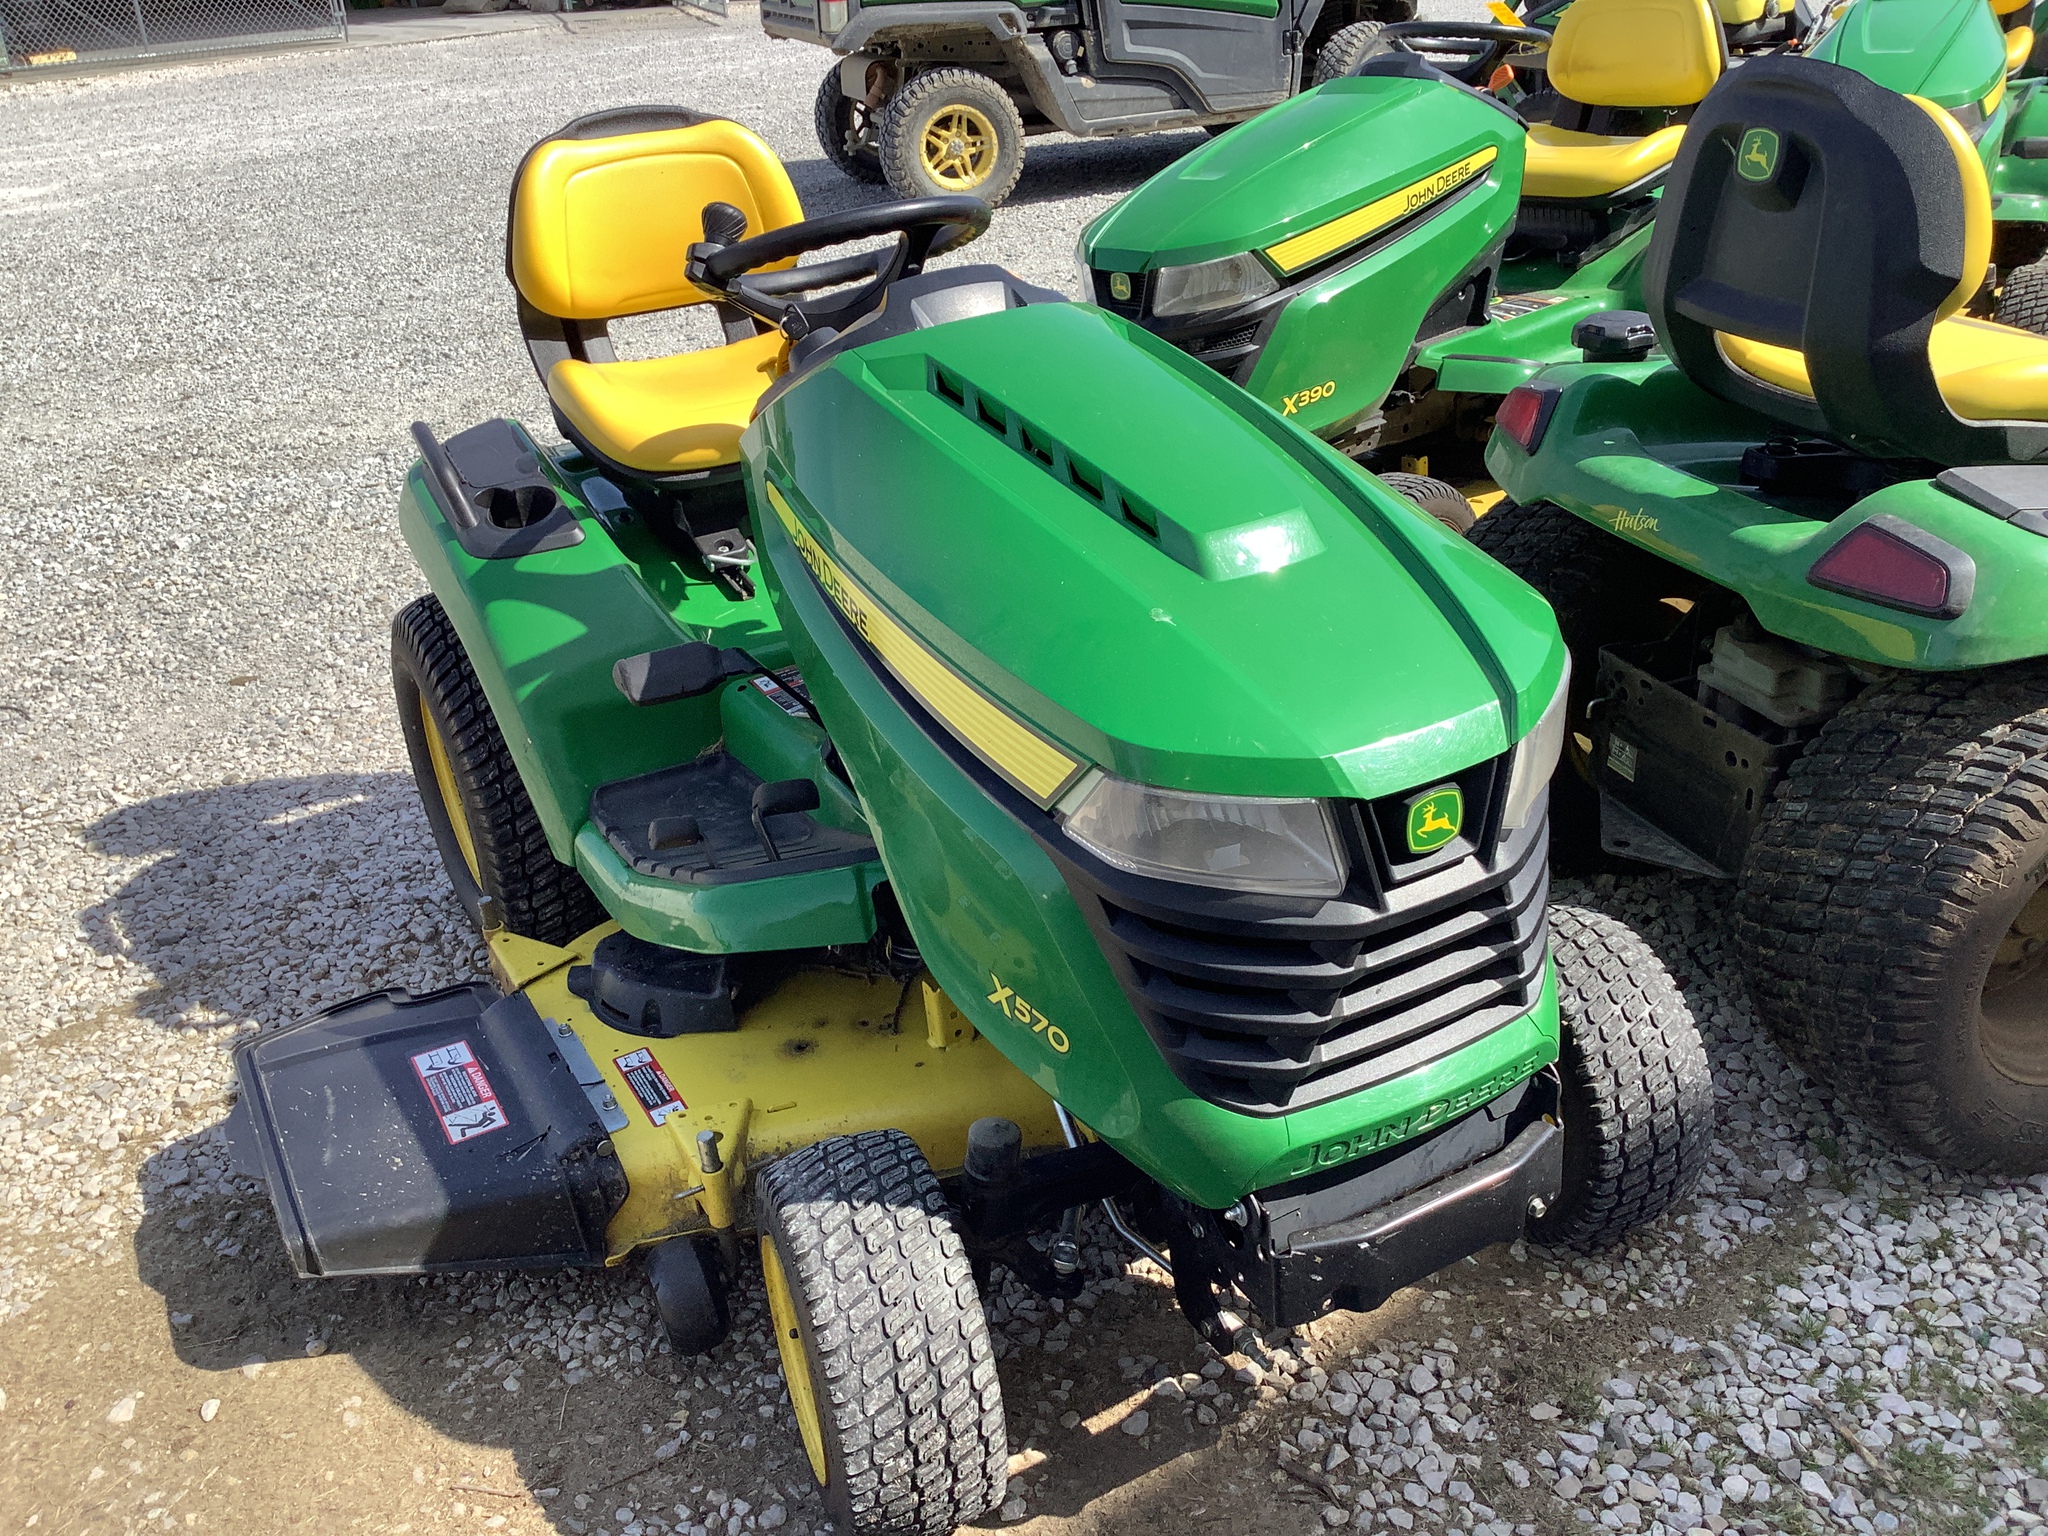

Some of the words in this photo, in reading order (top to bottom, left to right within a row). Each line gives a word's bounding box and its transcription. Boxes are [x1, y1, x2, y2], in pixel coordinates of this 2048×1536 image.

[1403, 184, 1435, 213] JOHN
[1437, 162, 1471, 193] DEERE
[1282, 380, 1336, 416] X390
[1609, 507, 1661, 532] Hutson
[792, 518, 821, 571] JOHN
[822, 559, 869, 637] DEERE
[986, 971, 1070, 1053] X570
[471, 1071, 492, 1099] DANGER
[1291, 1115, 1411, 1175] JOHN
[1417, 1051, 1540, 1131] DEERE
